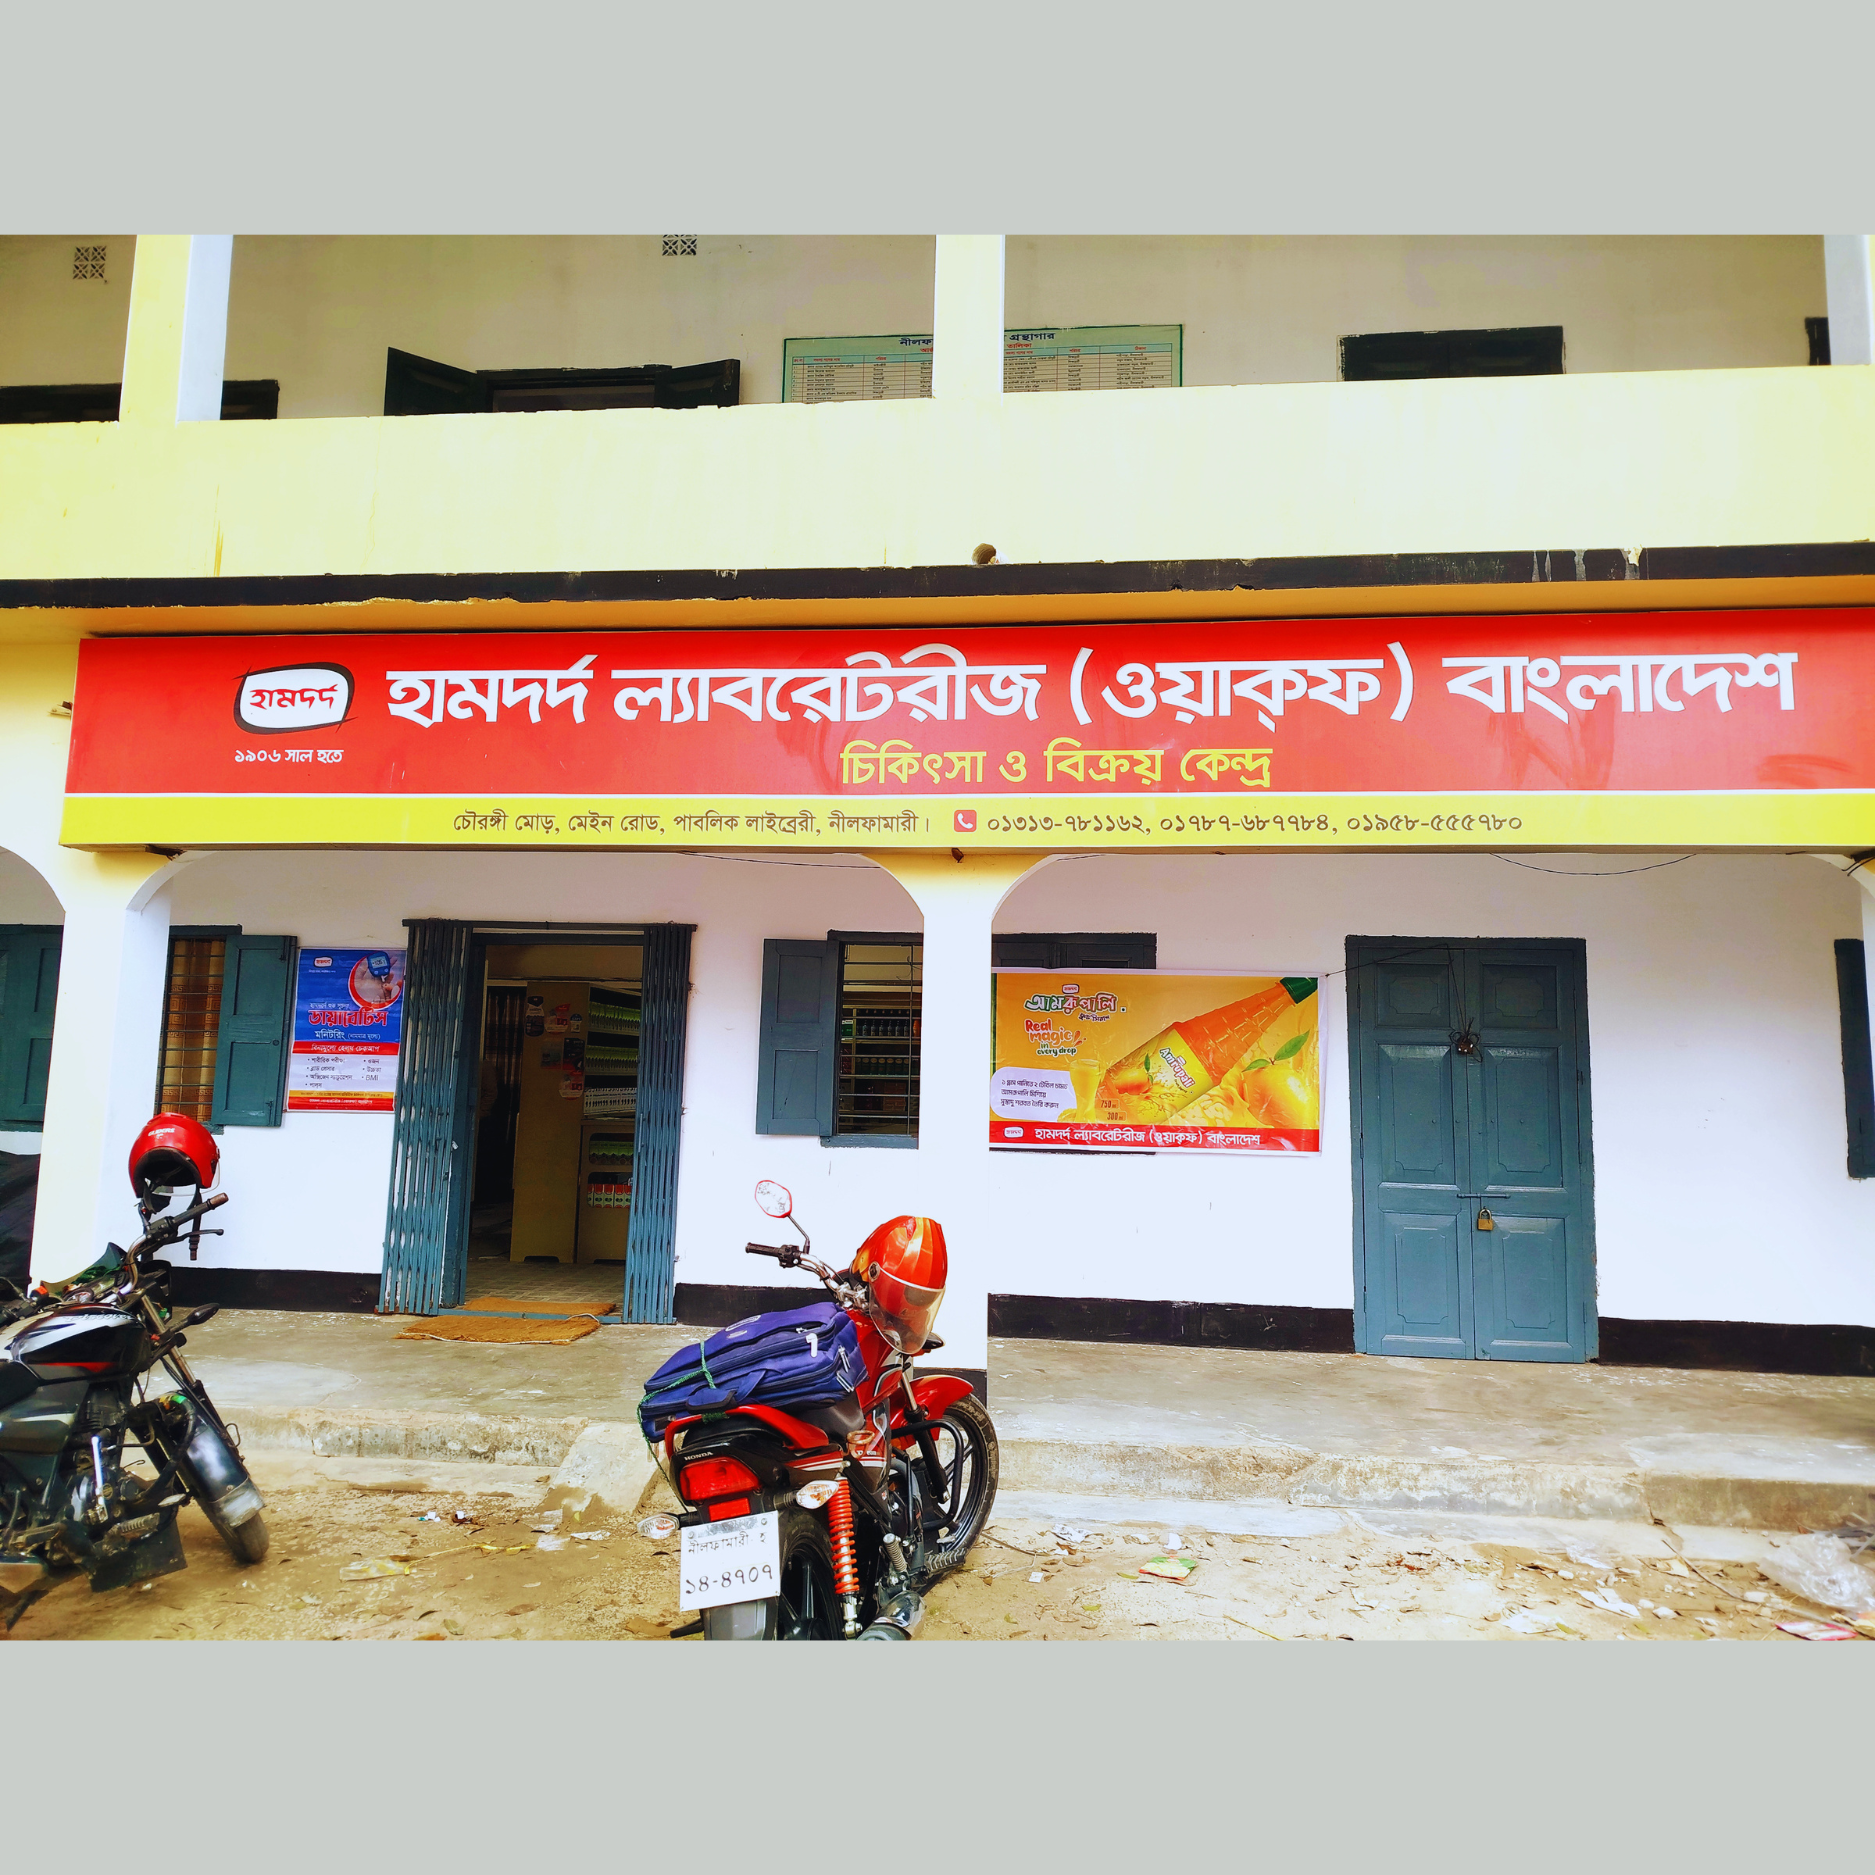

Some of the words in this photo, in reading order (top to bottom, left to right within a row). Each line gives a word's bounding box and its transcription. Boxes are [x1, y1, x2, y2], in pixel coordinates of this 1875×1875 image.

[899, 337, 933, 346] নীলফ
[386, 655, 596, 728] হামদর্দ
[612, 646, 1046, 723] ল্যাবরেটরীজ
[1442, 653, 1798, 724] বাংলাদেশ
[249, 684, 338, 710] হামদর্দ
[235, 750, 280, 762] ১৯০৬
[285, 750, 313, 762] সাল
[317, 750, 343, 763] হতে
[841, 742, 984, 782] চিকিৎসা
[1003, 753, 1024, 780] ও
[1045, 737, 1161, 784] বিক্রয়
[1182, 749, 1273, 787] কেন্দ্র
[454, 809, 508, 830] চৌরঙ্গী
[516, 815, 559, 834] মোড়,
[569, 810, 614, 832] মেইন
[621, 815, 664, 834] রোড,
[674, 810, 740, 831] পাবলিক
[745, 810, 820, 836] লাইব্রেরী,
[828, 810, 918, 832] নীলফামারী
[988, 815, 1150, 835] ০১৩১৩-৭৮১১৬২,
[1161, 815, 1337, 833] ০১৭৮৭-৬৮৭৭৮৪,
[1348, 814, 1521, 831] ০১৯৫৮-৫৫৫৭৮০
[308, 1007, 388, 1027] ডায়াবেটিস
[1025, 1018, 1052, 1032] Real
[1030, 1027, 1073, 1045] magic
[1037, 1048, 1058, 1056] every
[1059, 1047, 1077, 1055] drop
[1160, 1048, 1195, 1088] Amrupali
[1101, 1100, 1112, 1108] 750
[1034, 1127, 1071, 1140] হামদর্দ
[1073, 1127, 1145, 1143] ল্যাবরেটরীজ
[1207, 1133, 1261, 1146] বাংলাদেশ
[684, 1451, 714, 1461] HONDA
[685, 1564, 773, 1594] ১৪-৪৭০৭
